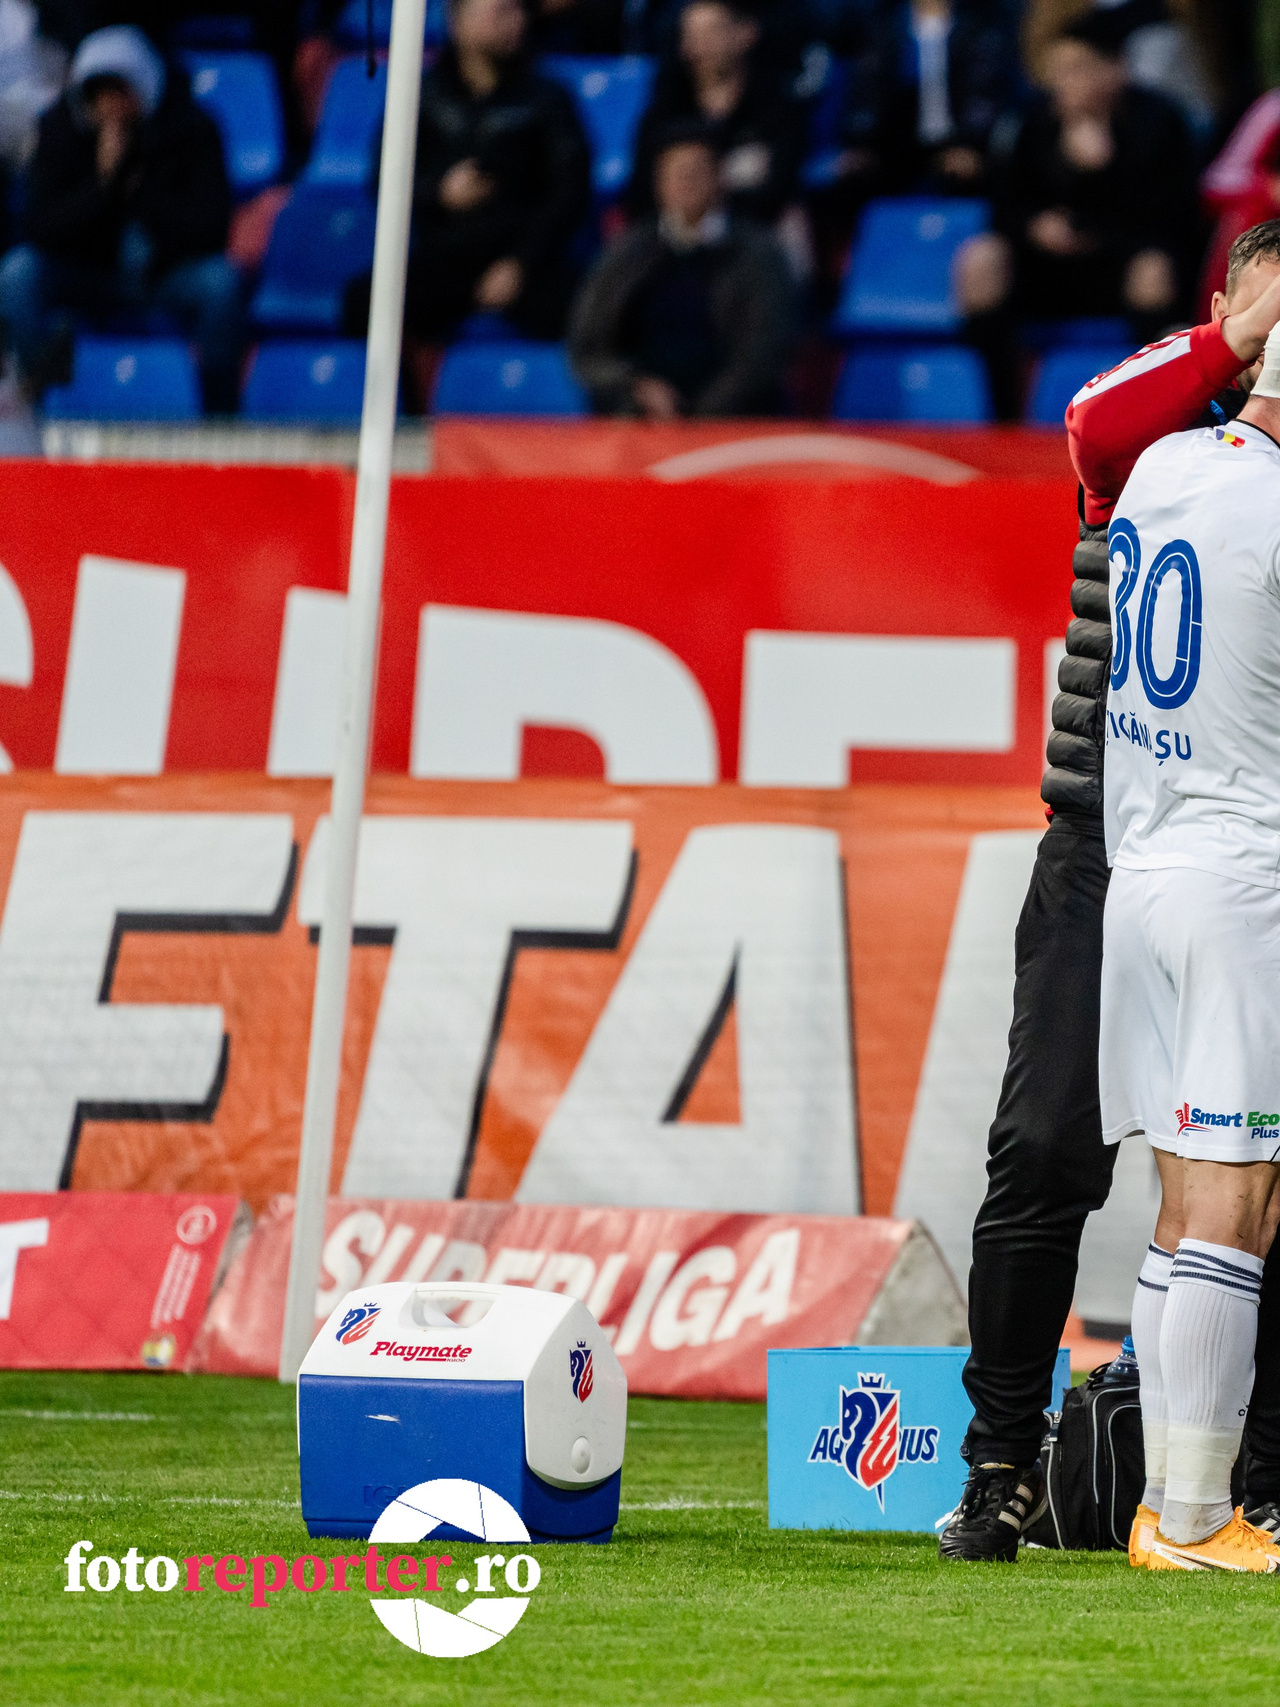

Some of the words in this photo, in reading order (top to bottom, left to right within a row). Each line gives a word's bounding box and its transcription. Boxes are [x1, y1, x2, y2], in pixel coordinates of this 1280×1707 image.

[1108, 517, 1202, 710] 30
[1190, 1108, 1243, 1128] Smart
[1246, 1111, 1280, 1127] Eco
[1251, 1126, 1280, 1139] Plus
[370, 1341, 473, 1362] Playmate
[808, 1427, 939, 1465] AQIUS
